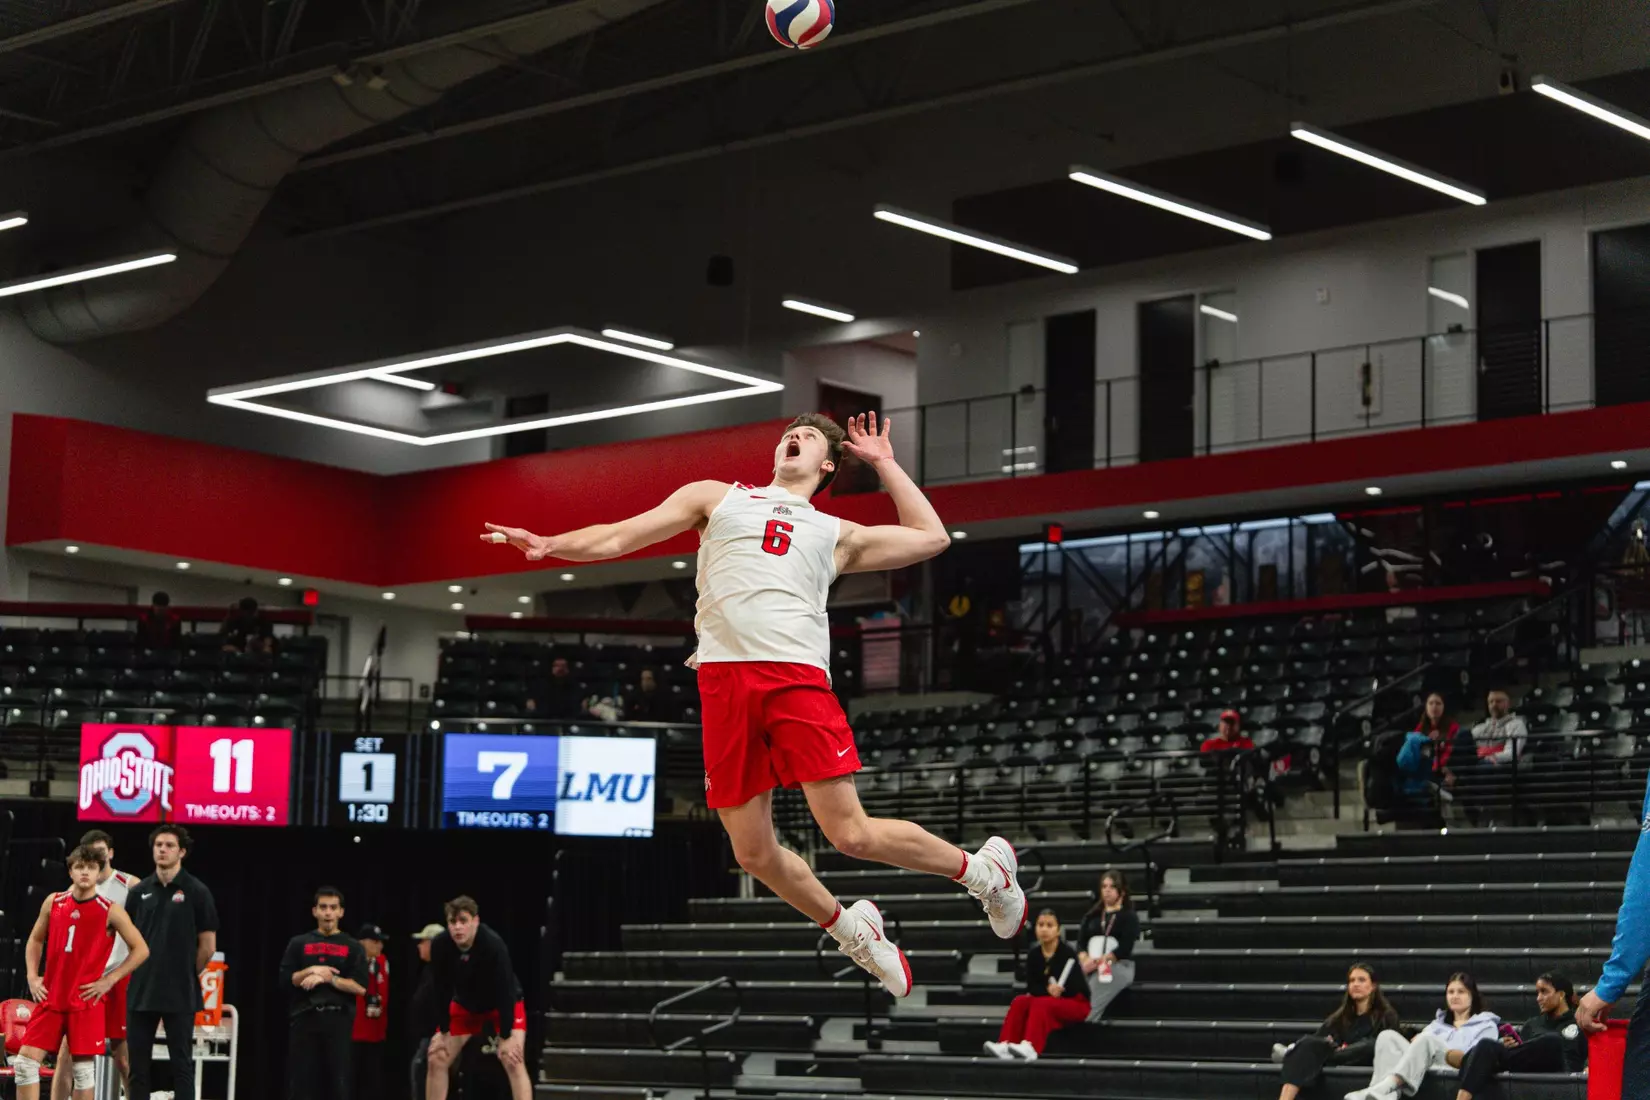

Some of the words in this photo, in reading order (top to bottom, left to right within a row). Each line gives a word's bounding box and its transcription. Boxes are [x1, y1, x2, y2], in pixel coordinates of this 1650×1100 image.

[761, 519, 794, 556] 6
[355, 737, 383, 751] SET
[209, 738, 254, 793] 11
[362, 761, 373, 792] 1
[477, 751, 528, 799] 7
[560, 773, 652, 802] LMU
[185, 804, 262, 820] TIMEOUTS:
[266, 806, 275, 821] 2
[348, 804, 389, 822] 1:30
[457, 811, 534, 828] TIMEOUTS:
[538, 813, 548, 829] 2
[64, 924, 76, 953] 1
[201, 971, 219, 991] G
